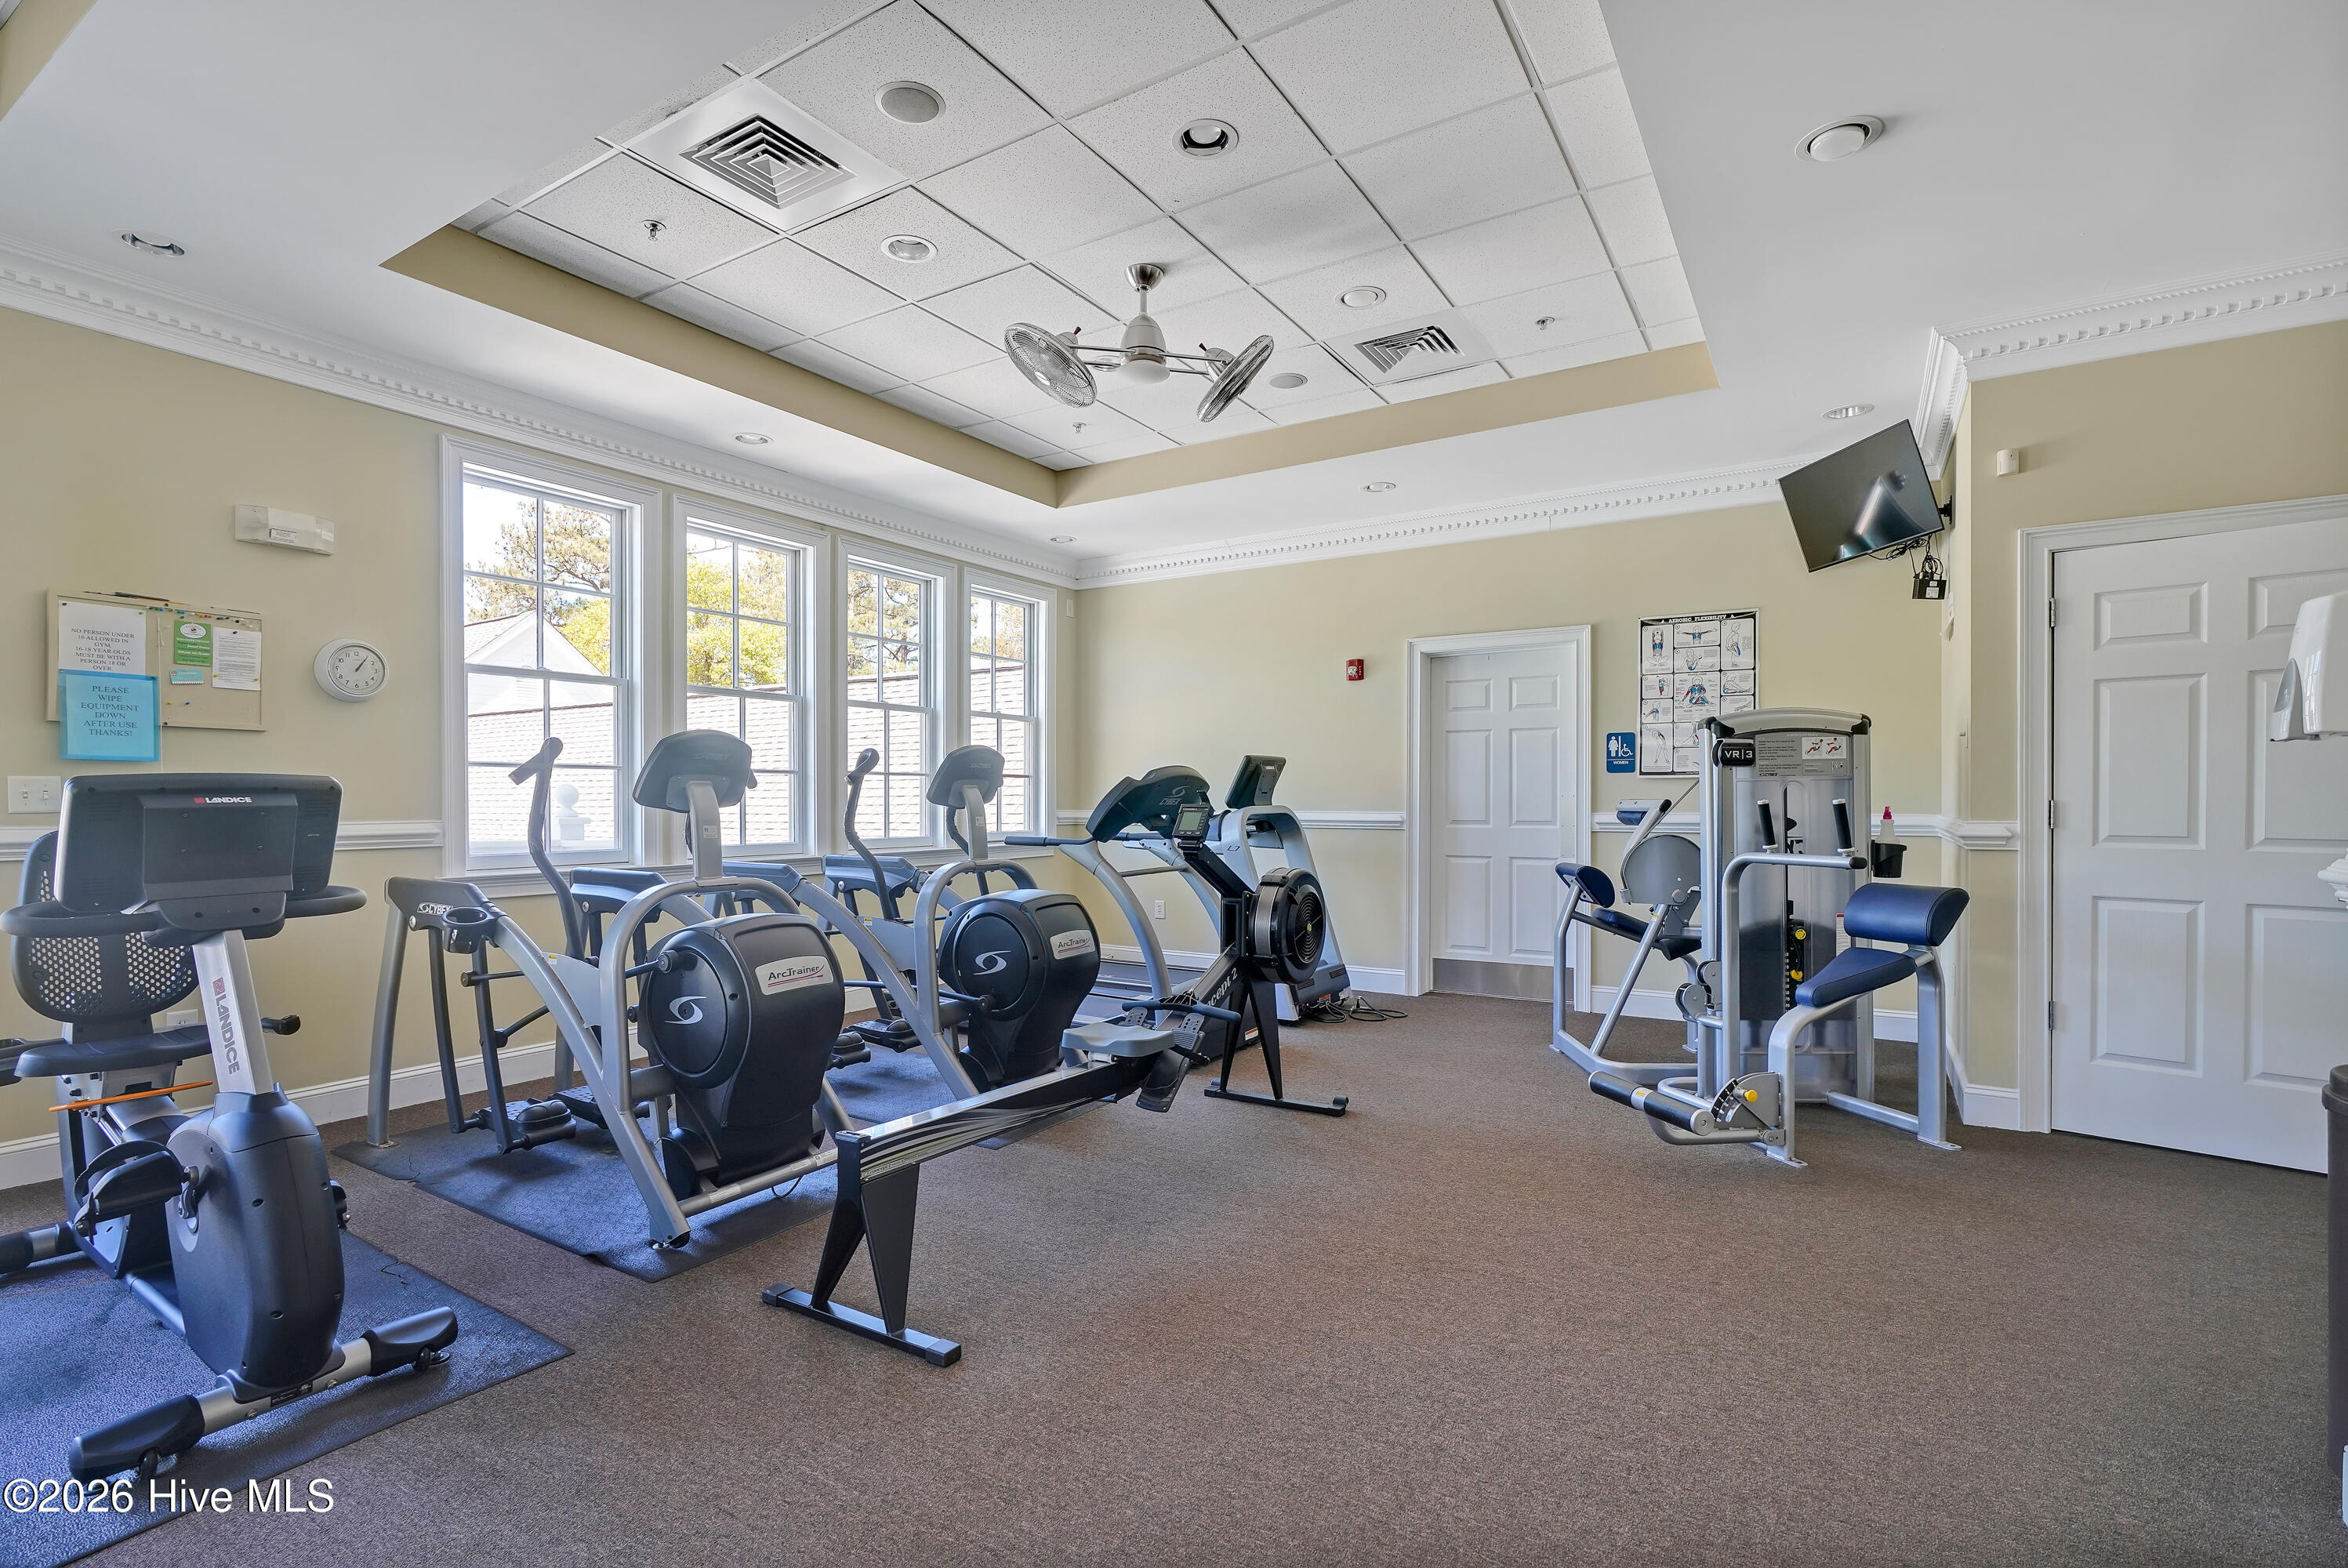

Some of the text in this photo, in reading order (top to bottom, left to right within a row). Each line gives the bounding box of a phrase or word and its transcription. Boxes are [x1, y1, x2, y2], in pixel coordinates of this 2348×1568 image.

[92, 685, 129, 694] PLEASE
[81, 702, 140, 711] EQUIPMENT
[88, 728, 132, 737] THANKS!
[1058, 938, 1088, 949] ArcTrainer
[768, 966, 820, 981] ArcTrainer
[1232, 967, 1238, 980] 2
[216, 993, 240, 1075] LANDICE
